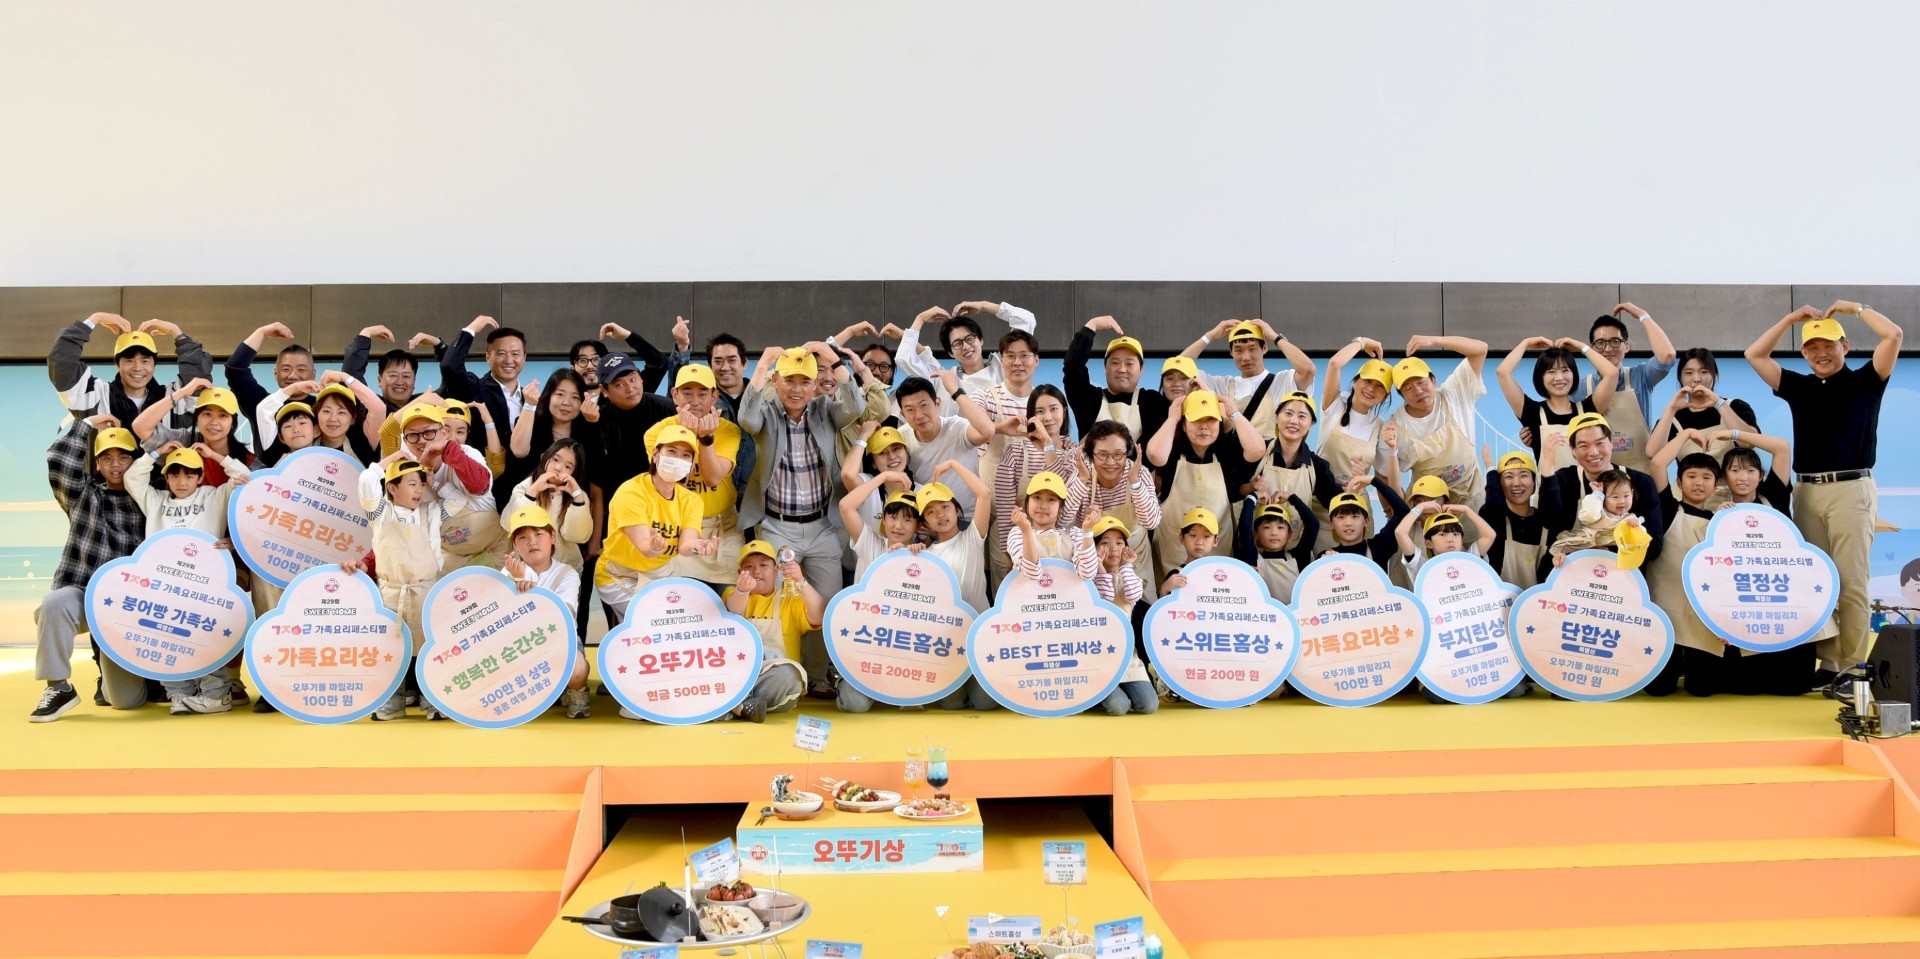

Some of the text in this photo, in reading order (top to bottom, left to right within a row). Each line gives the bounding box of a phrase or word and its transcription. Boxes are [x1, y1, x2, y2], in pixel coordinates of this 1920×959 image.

[298, 478, 347, 501] SWEET HOME
[317, 476, 335, 486] 제29회
[303, 496, 368, 528] 가족요리페스티벌
[258, 504, 354, 552] 가족요리상
[261, 540, 294, 558] 오뚜기몰
[176, 560, 195, 570] 제29회
[267, 555, 300, 574] 100만
[1746, 557, 1813, 566] 가족요리페스티벌
[156, 565, 209, 584] SWEET HOME
[1733, 573, 1790, 593] 열정상
[902, 582, 920, 590] 제29회
[1332, 585, 1350, 593] 제29회
[163, 583, 234, 610] 가족요리페스티벌
[884, 589, 936, 604] SWEET HOME
[1197, 596, 1223, 604] SWEET
[1317, 591, 1368, 606] SWEET HOME
[1571, 589, 1623, 604] SWEET HOME
[122, 596, 216, 632] 붕어빵 가족상
[304, 608, 356, 616] SWEET HOME
[460, 602, 478, 616] 제29회
[1021, 601, 1074, 613] SWEET HOME
[1332, 602, 1402, 622] 가족요리페스티벌
[1454, 598, 1513, 620] 가족요리페스티벌
[1580, 606, 1651, 627] 가족요리페스티벌
[1731, 612, 1797, 620] 오뚜기몰 마일리지
[451, 602, 499, 634] SWEET HOME
[471, 601, 537, 644] 가족요리페스티벌
[651, 615, 703, 627] SWEET HOME
[893, 608, 964, 627] 가족요리페스티벌
[1035, 616, 1107, 630] 가족요리페스티벌
[1209, 612, 1276, 623] 가족요리페스티벌
[315, 625, 387, 634] 가족요리페스티벌
[665, 627, 736, 642] 가족요리페스티벌
[1438, 618, 1506, 650] 부지런상
[1561, 621, 1621, 649] 단합상
[1746, 624, 1784, 634] 10만 원
[124, 631, 195, 656] 오뚜기몰 마일리지
[853, 625, 953, 657] 스위트홈상
[999, 640, 1102, 660] BEST 드레서상
[1175, 632, 1271, 654] 스위트홈상
[1302, 624, 1400, 657] 가족요리상
[136, 647, 177, 666] 10만 원
[277, 646, 379, 668] 가족요리상
[452, 626, 547, 690] 행복한 순간상
[638, 646, 726, 675] 오뚜기상
[860, 661, 936, 683] 현금 200만 원
[1185, 668, 1259, 681] 현금 200만 원
[1322, 661, 1391, 680] 오뚜기몰 마일리지
[1451, 656, 1509, 678] 오뚜기몰 마일리지
[1549, 657, 1619, 676] 오뚜기몰 마일리지
[292, 682, 363, 692] 오뚜기몰 마일리지
[479, 661, 550, 708] 300만 원 상당
[1018, 675, 1088, 689] 오뚜기몰 마일리지
[1334, 674, 1383, 691] 100만 원
[1465, 670, 1500, 688] 10만 원
[1561, 672, 1602, 688] 10만 원
[303, 695, 353, 706] 100만 원
[510, 691, 527, 706] 여행
[527, 678, 552, 696] 상품권
[647, 683, 725, 702] 현금 500만 원
[1033, 688, 1075, 701] 10만 원
[813, 838, 905, 863] 오뚜기상
[988, 930, 1021, 938] 스위트홈상
